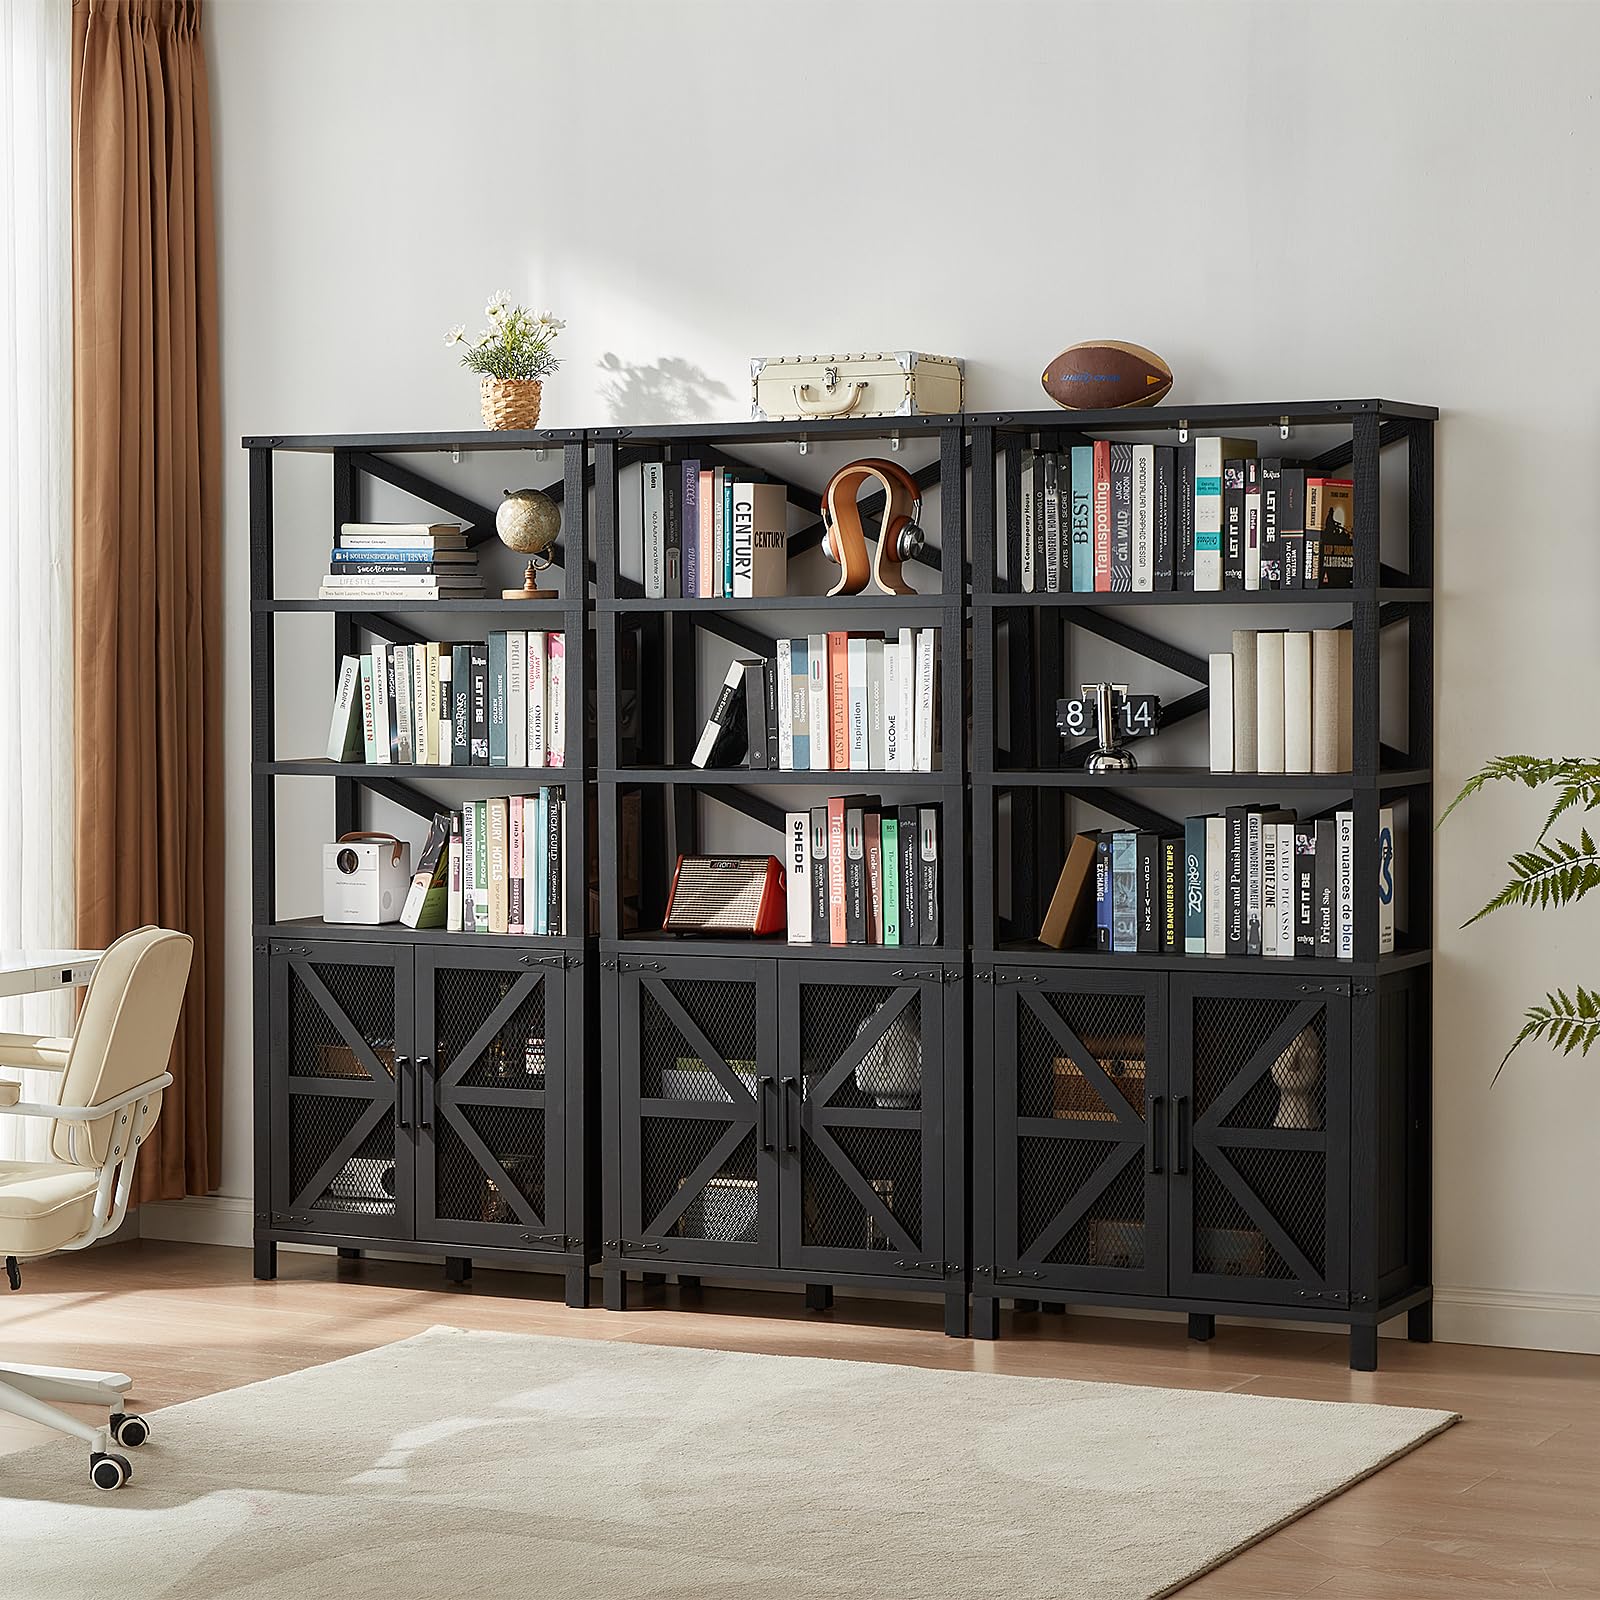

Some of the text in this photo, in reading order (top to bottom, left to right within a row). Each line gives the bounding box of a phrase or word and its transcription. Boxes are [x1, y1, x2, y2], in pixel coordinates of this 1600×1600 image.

[686, 466, 696, 506] REBECCA
[735, 502, 752, 580] CENTURY
[754, 531, 785, 548] CENTURY
[1024, 512, 1032, 560] Contemporary
[1073, 490, 1089, 544] BEST
[1230, 507, 1238, 558] LET IT BE
[1266, 491, 1276, 543] LET IT BE
[406, 553, 428, 561] BASEL
[1047, 499, 1057, 589] CREATE WONDERFUL HOMELIFE
[340, 667, 352, 710] GERALDINE
[396, 650, 408, 733] CREATE WONDERFUL HOMELIFE
[511, 640, 520, 693] SPECIAL ISSUE
[364, 676, 374, 742] NINSMODE
[456, 692, 467, 720] RINGS
[475, 675, 483, 723] LET IT BE
[834, 672, 844, 764] CASTA LAETITIA
[1067, 700, 1084, 727] 8
[1121, 701, 1152, 728] 14
[455, 725, 467, 747] LORD
[854, 702, 863, 750] Inspiration
[888, 715, 896, 761] WELCOME
[464, 806, 473, 890] CREATE WONDERFUL HOMELIFE
[492, 805, 502, 881] LUXURY HOTELS
[514, 838, 519, 848] UN
[550, 804, 558, 861] TRICIA GUILD
[794, 821, 803, 874] SHEDE
[870, 848, 879, 870] Uncle
[871, 871, 879, 894] Tom's
[889, 880, 895, 888] of
[1167, 871, 1174, 882] DU
[1230, 818, 1241, 941] Crime and Punishment
[1249, 818, 1259, 910] CREATE WONDERFUL HOMELIFE
[1264, 843, 1276, 908] DIE ROTE ZONE
[1281, 840, 1290, 941] PABLO PICASSO
[1301, 872, 1310, 924] LET IT BE
[1341, 819, 1353, 951] Les nuances de bleu
[513, 915, 519, 924] LA
[1320, 888, 1331, 944] Friend Ship
